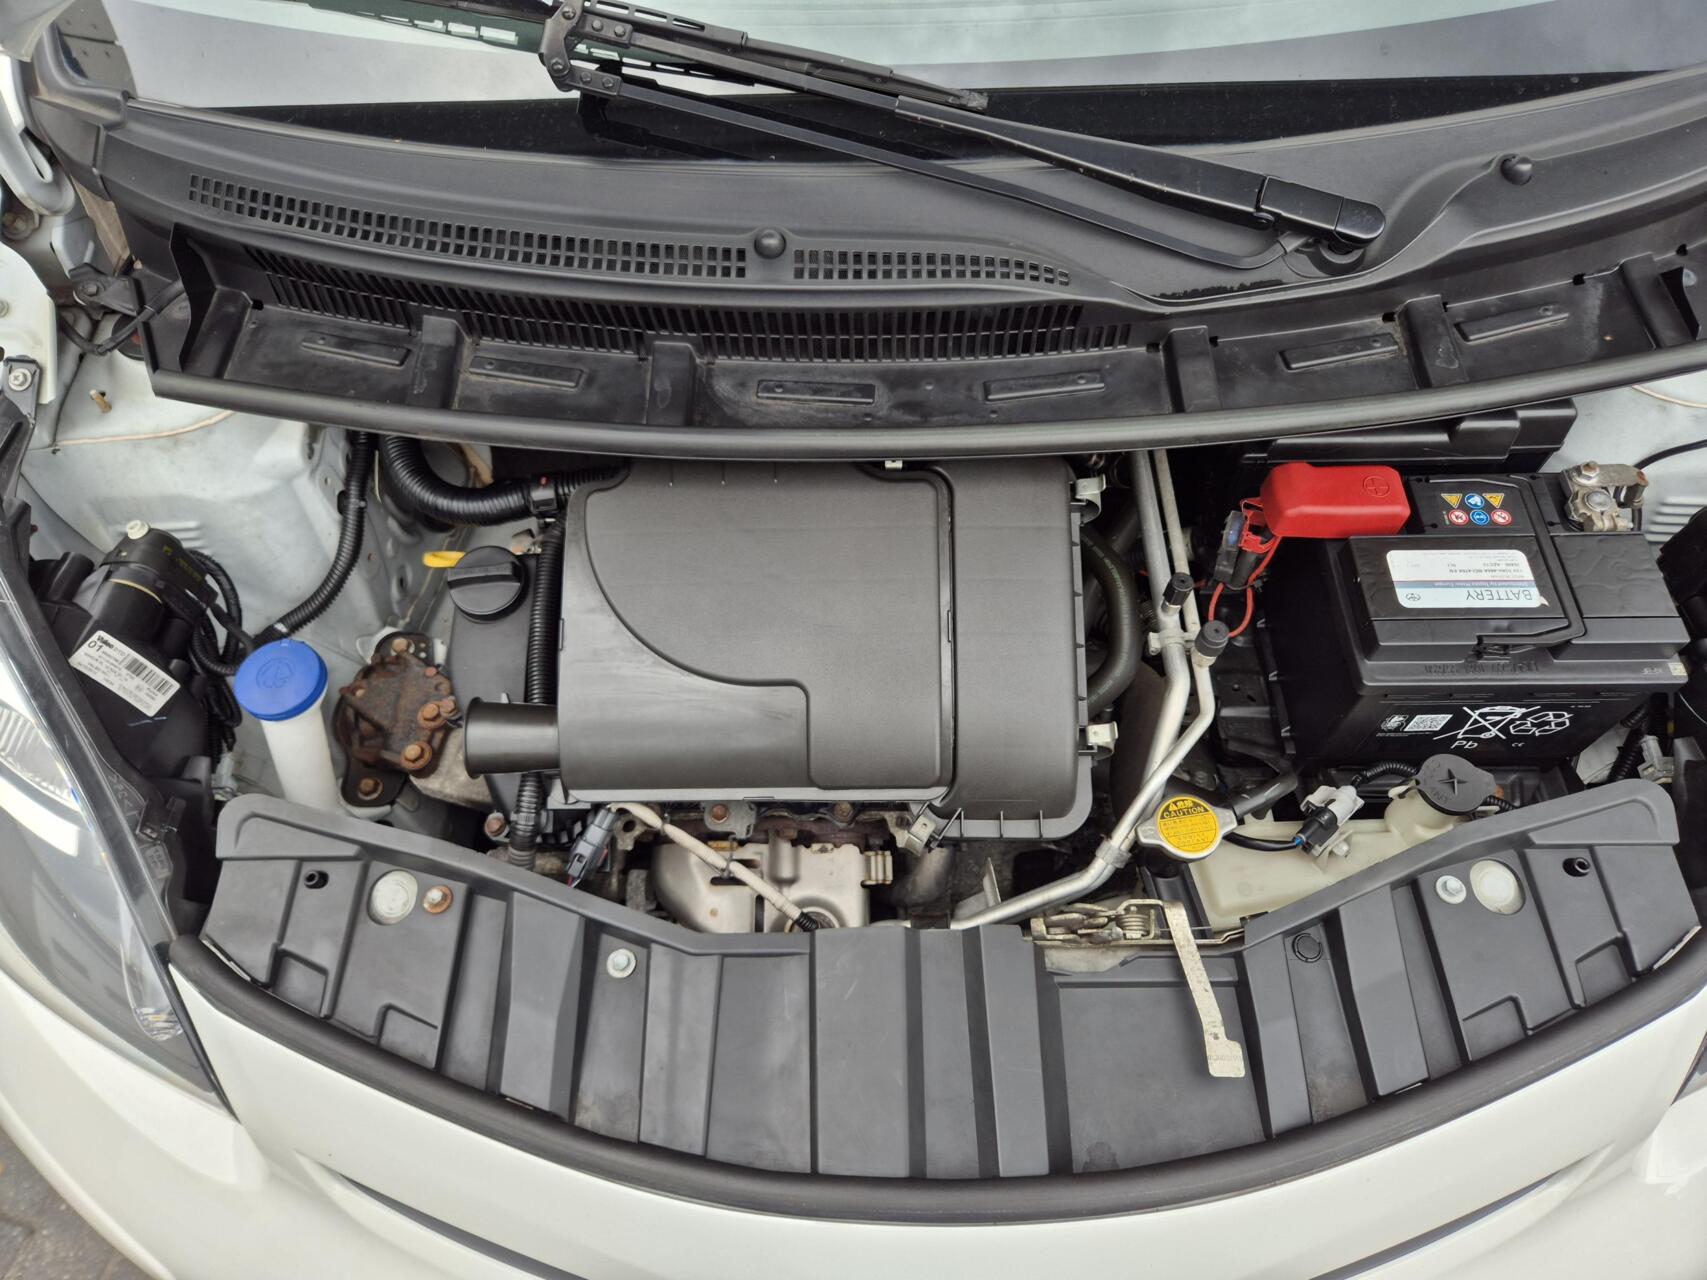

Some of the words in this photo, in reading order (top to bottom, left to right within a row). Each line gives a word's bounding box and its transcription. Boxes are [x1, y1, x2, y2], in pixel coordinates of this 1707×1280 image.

[1466, 589, 1533, 601] BATTERY
[1450, 740, 1478, 749] Pb
[1163, 806, 1205, 819] CAUTION
